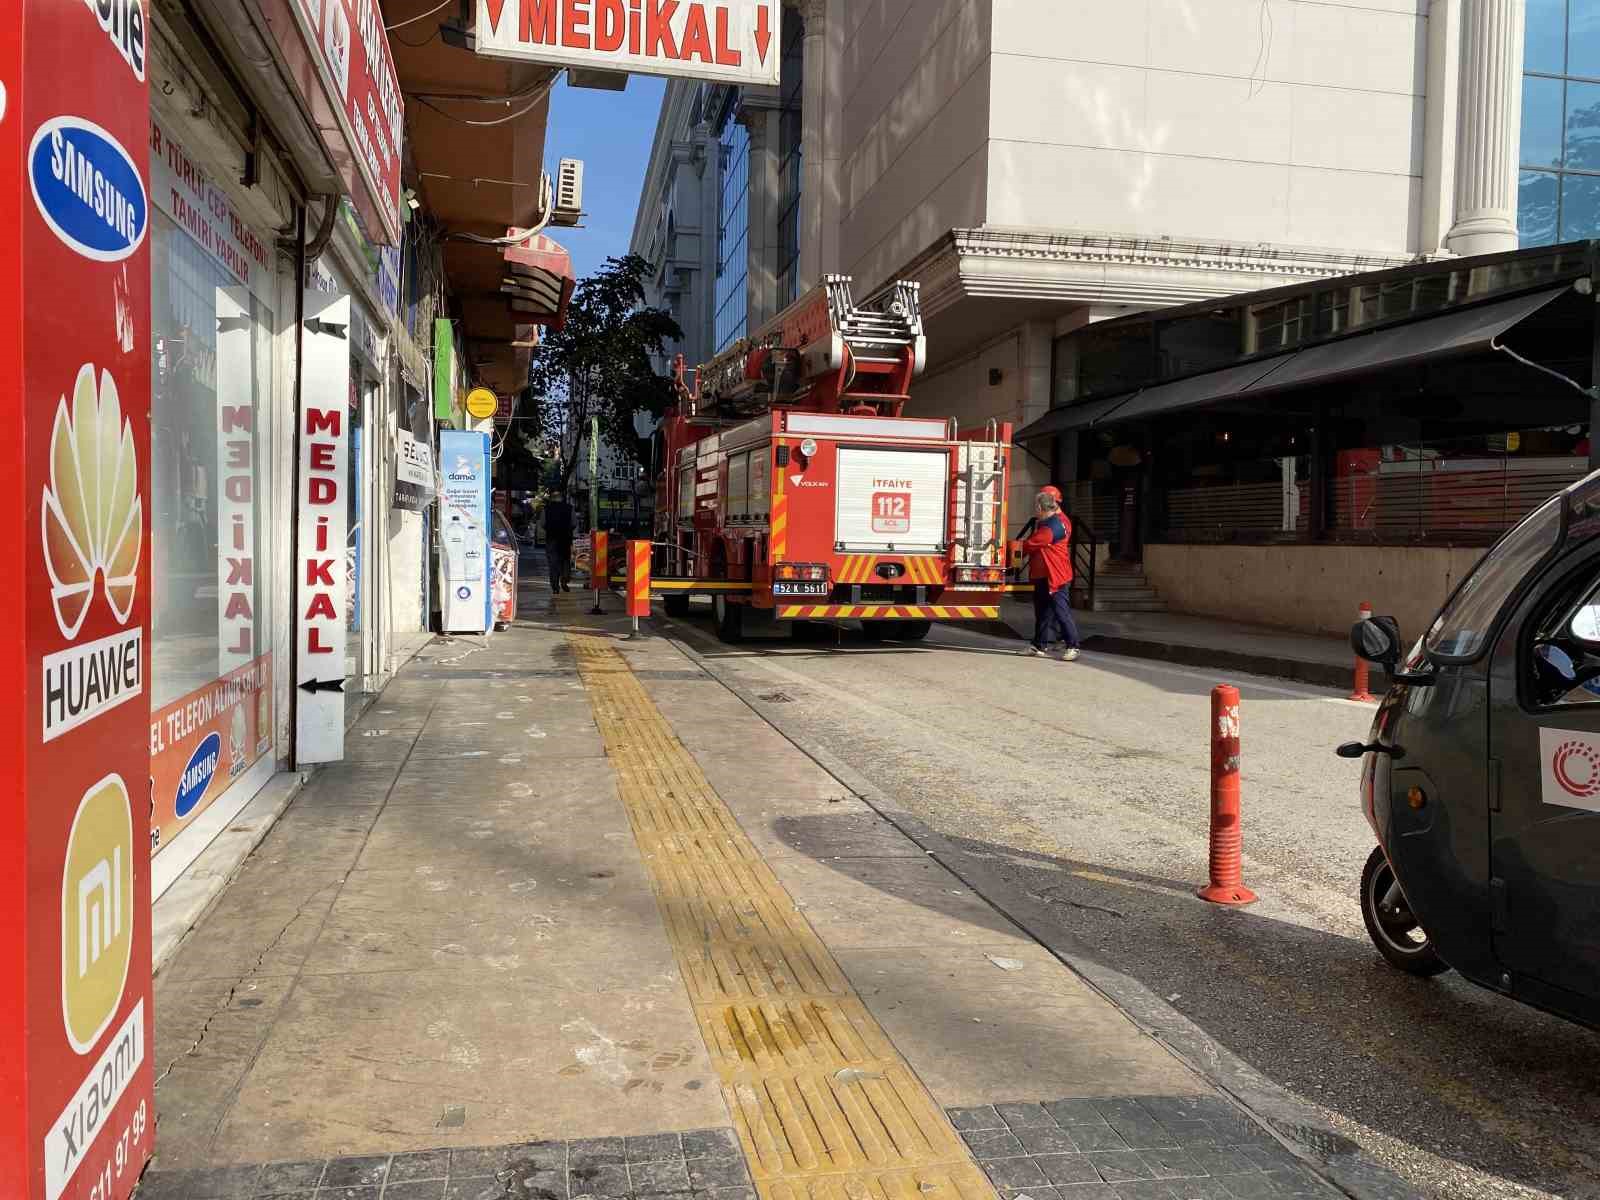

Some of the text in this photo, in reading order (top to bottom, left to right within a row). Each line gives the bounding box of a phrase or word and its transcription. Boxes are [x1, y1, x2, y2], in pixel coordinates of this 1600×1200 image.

[51, 126, 136, 247] SAMSUNG
[208, 187, 226, 223] CEP
[171, 187, 249, 285] TAMİRİ YAPILIR
[872, 475, 912, 488] İTFAİYE
[877, 496, 905, 516] 112
[780, 583, 791, 593] 52
[793, 583, 799, 593] K
[46, 637, 140, 728] HUAWEI
[167, 691, 213, 745] TELEFON
[181, 752, 216, 796] SAMSUNG
[116, 1140, 130, 1178] 97
[133, 1098, 146, 1146] 99
